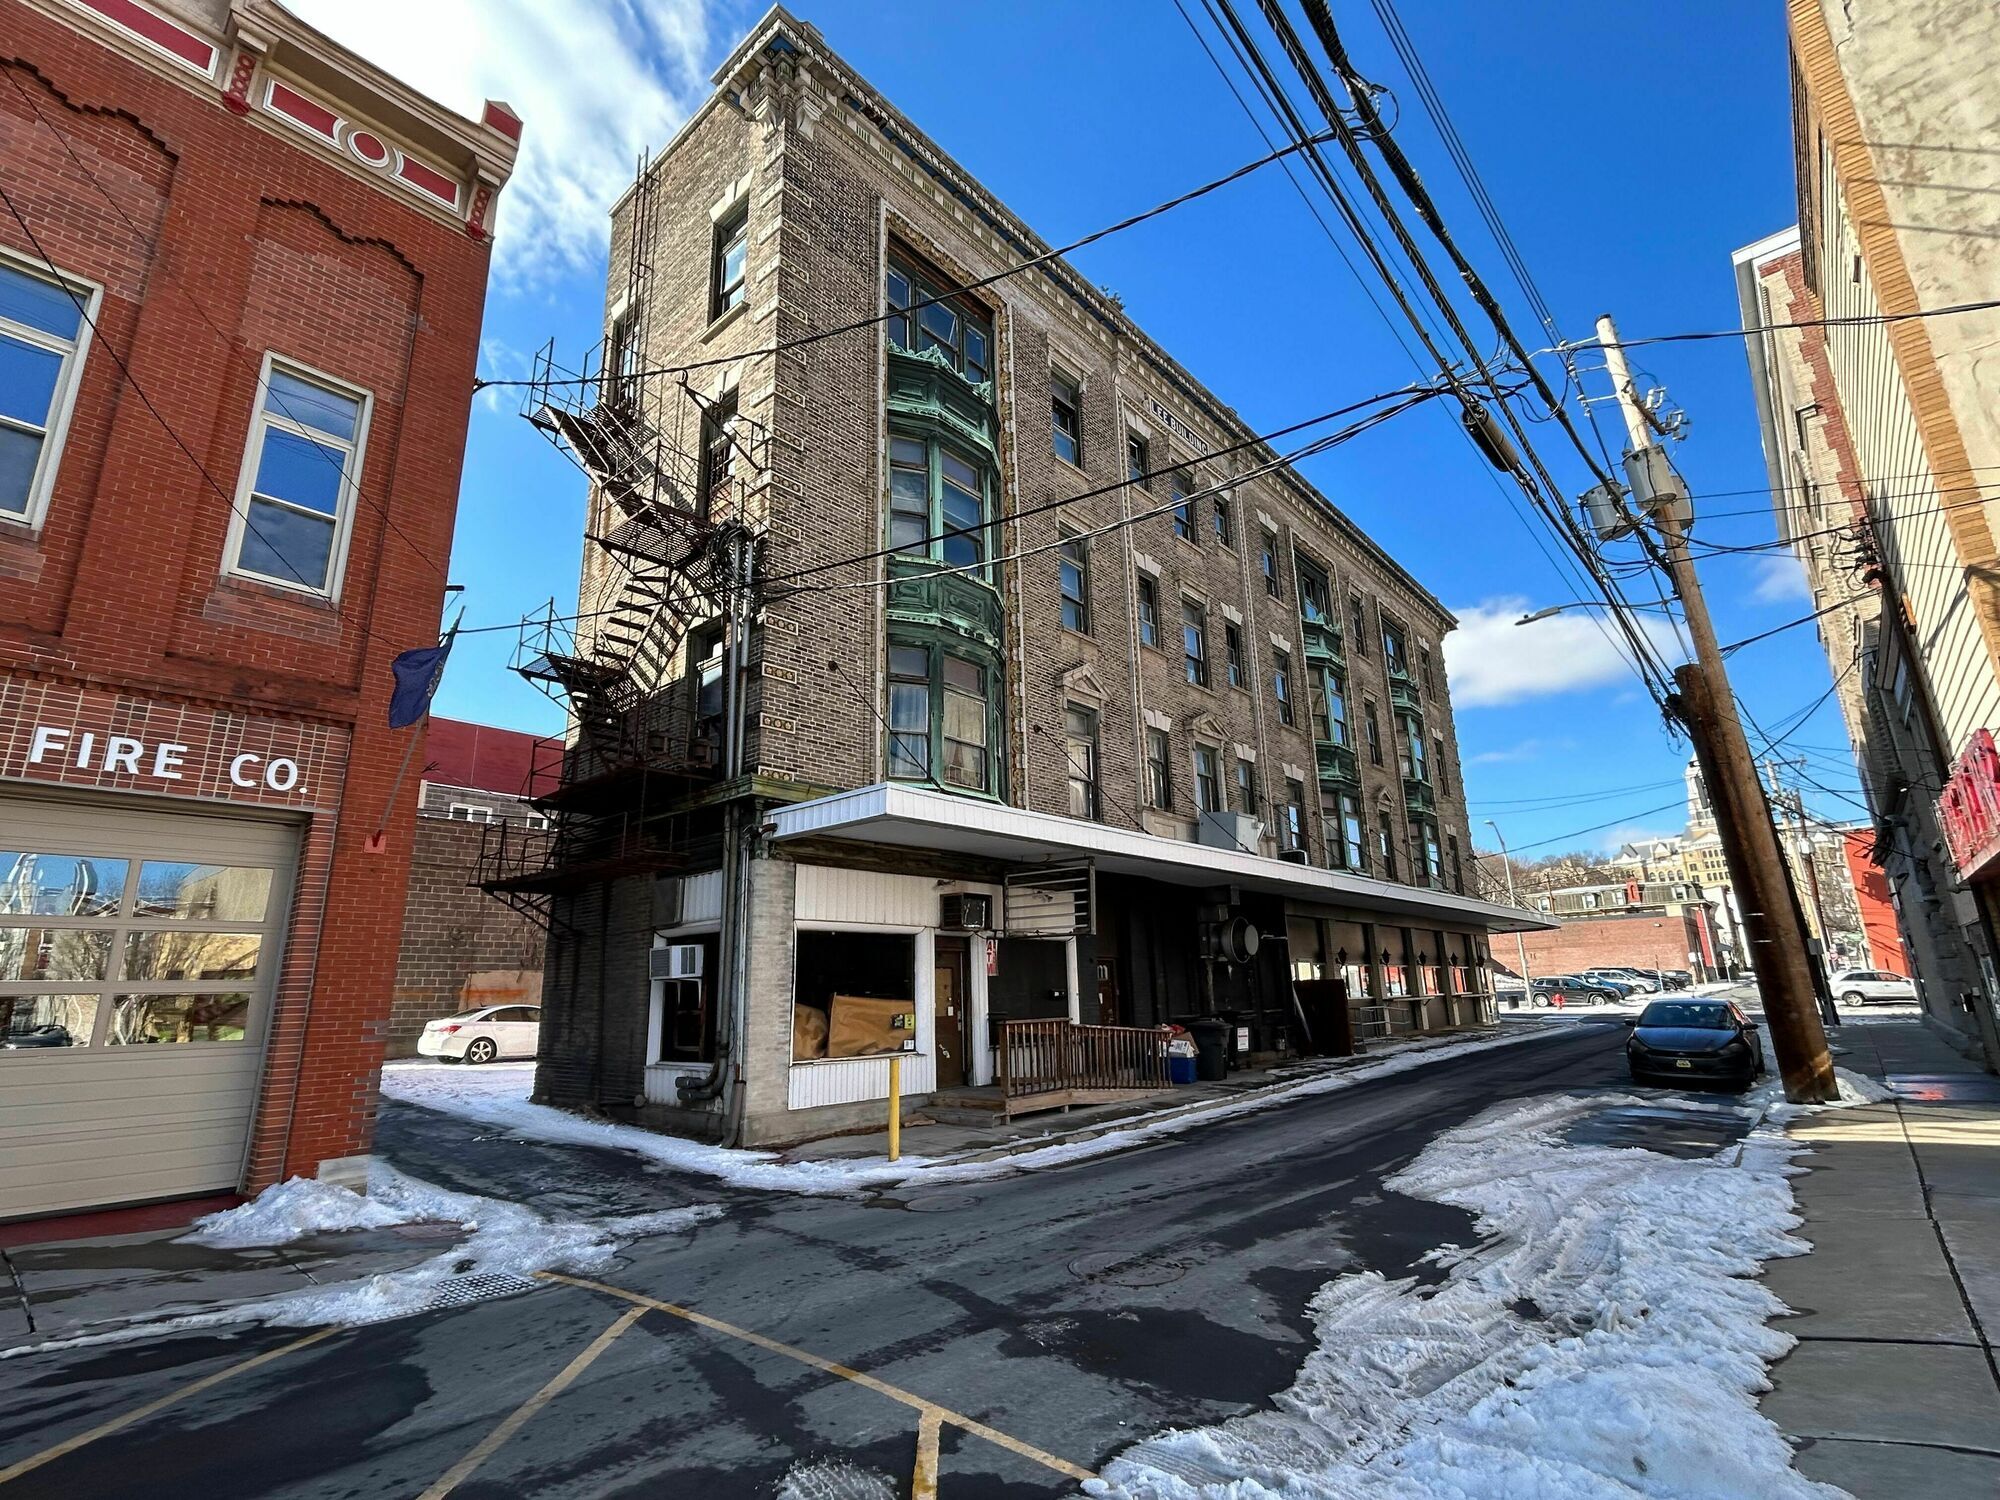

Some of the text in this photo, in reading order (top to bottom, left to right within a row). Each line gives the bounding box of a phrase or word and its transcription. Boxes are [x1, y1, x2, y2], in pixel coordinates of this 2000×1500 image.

[1151, 400, 1207, 455] LEE BUILDING
[30, 727, 308, 794] FIRE CO.
